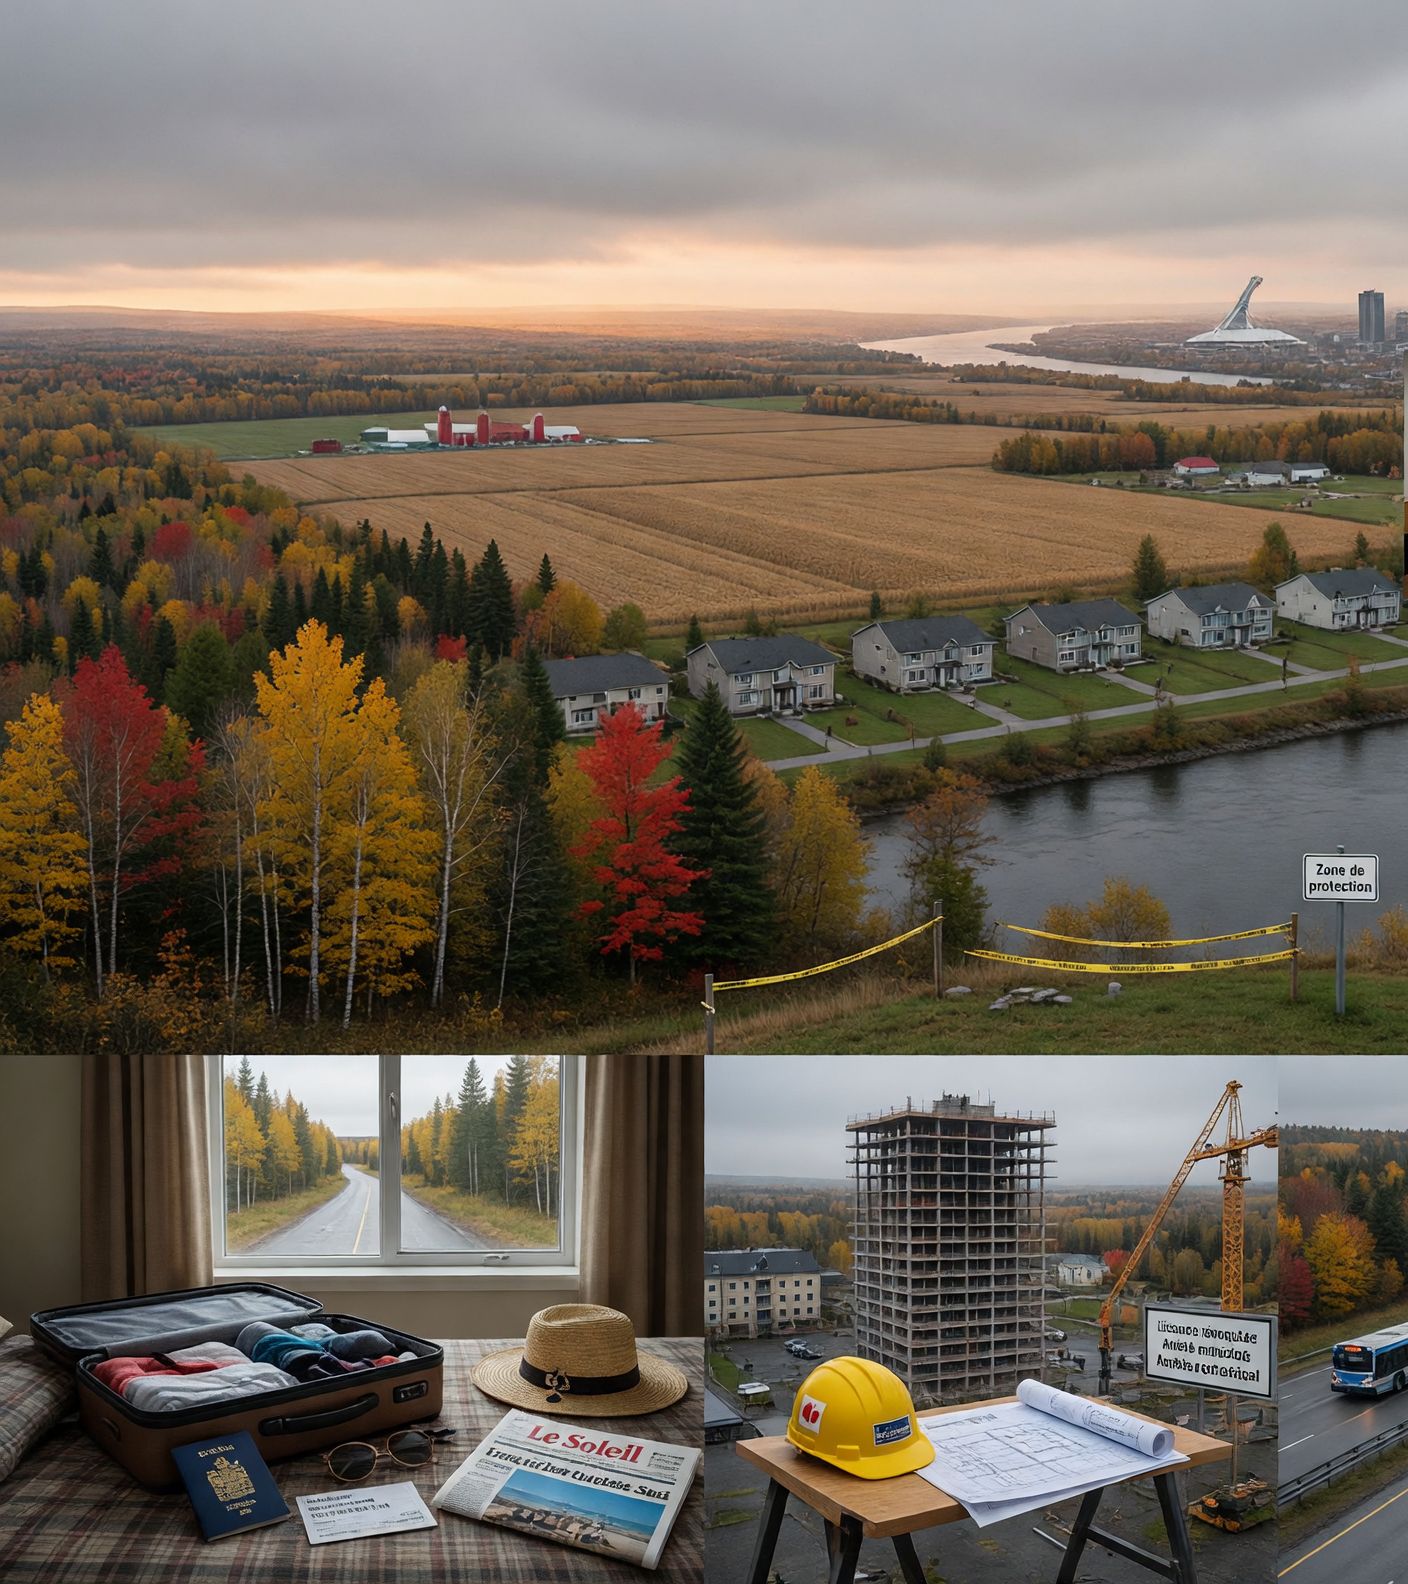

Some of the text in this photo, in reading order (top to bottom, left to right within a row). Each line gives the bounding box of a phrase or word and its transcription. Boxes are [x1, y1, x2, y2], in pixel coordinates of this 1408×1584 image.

[1316, 863, 1365, 877] Zone de
[1309, 880, 1373, 895] protection
[527, 1425, 559, 1444] Le
[561, 1433, 645, 1464] Soleil
